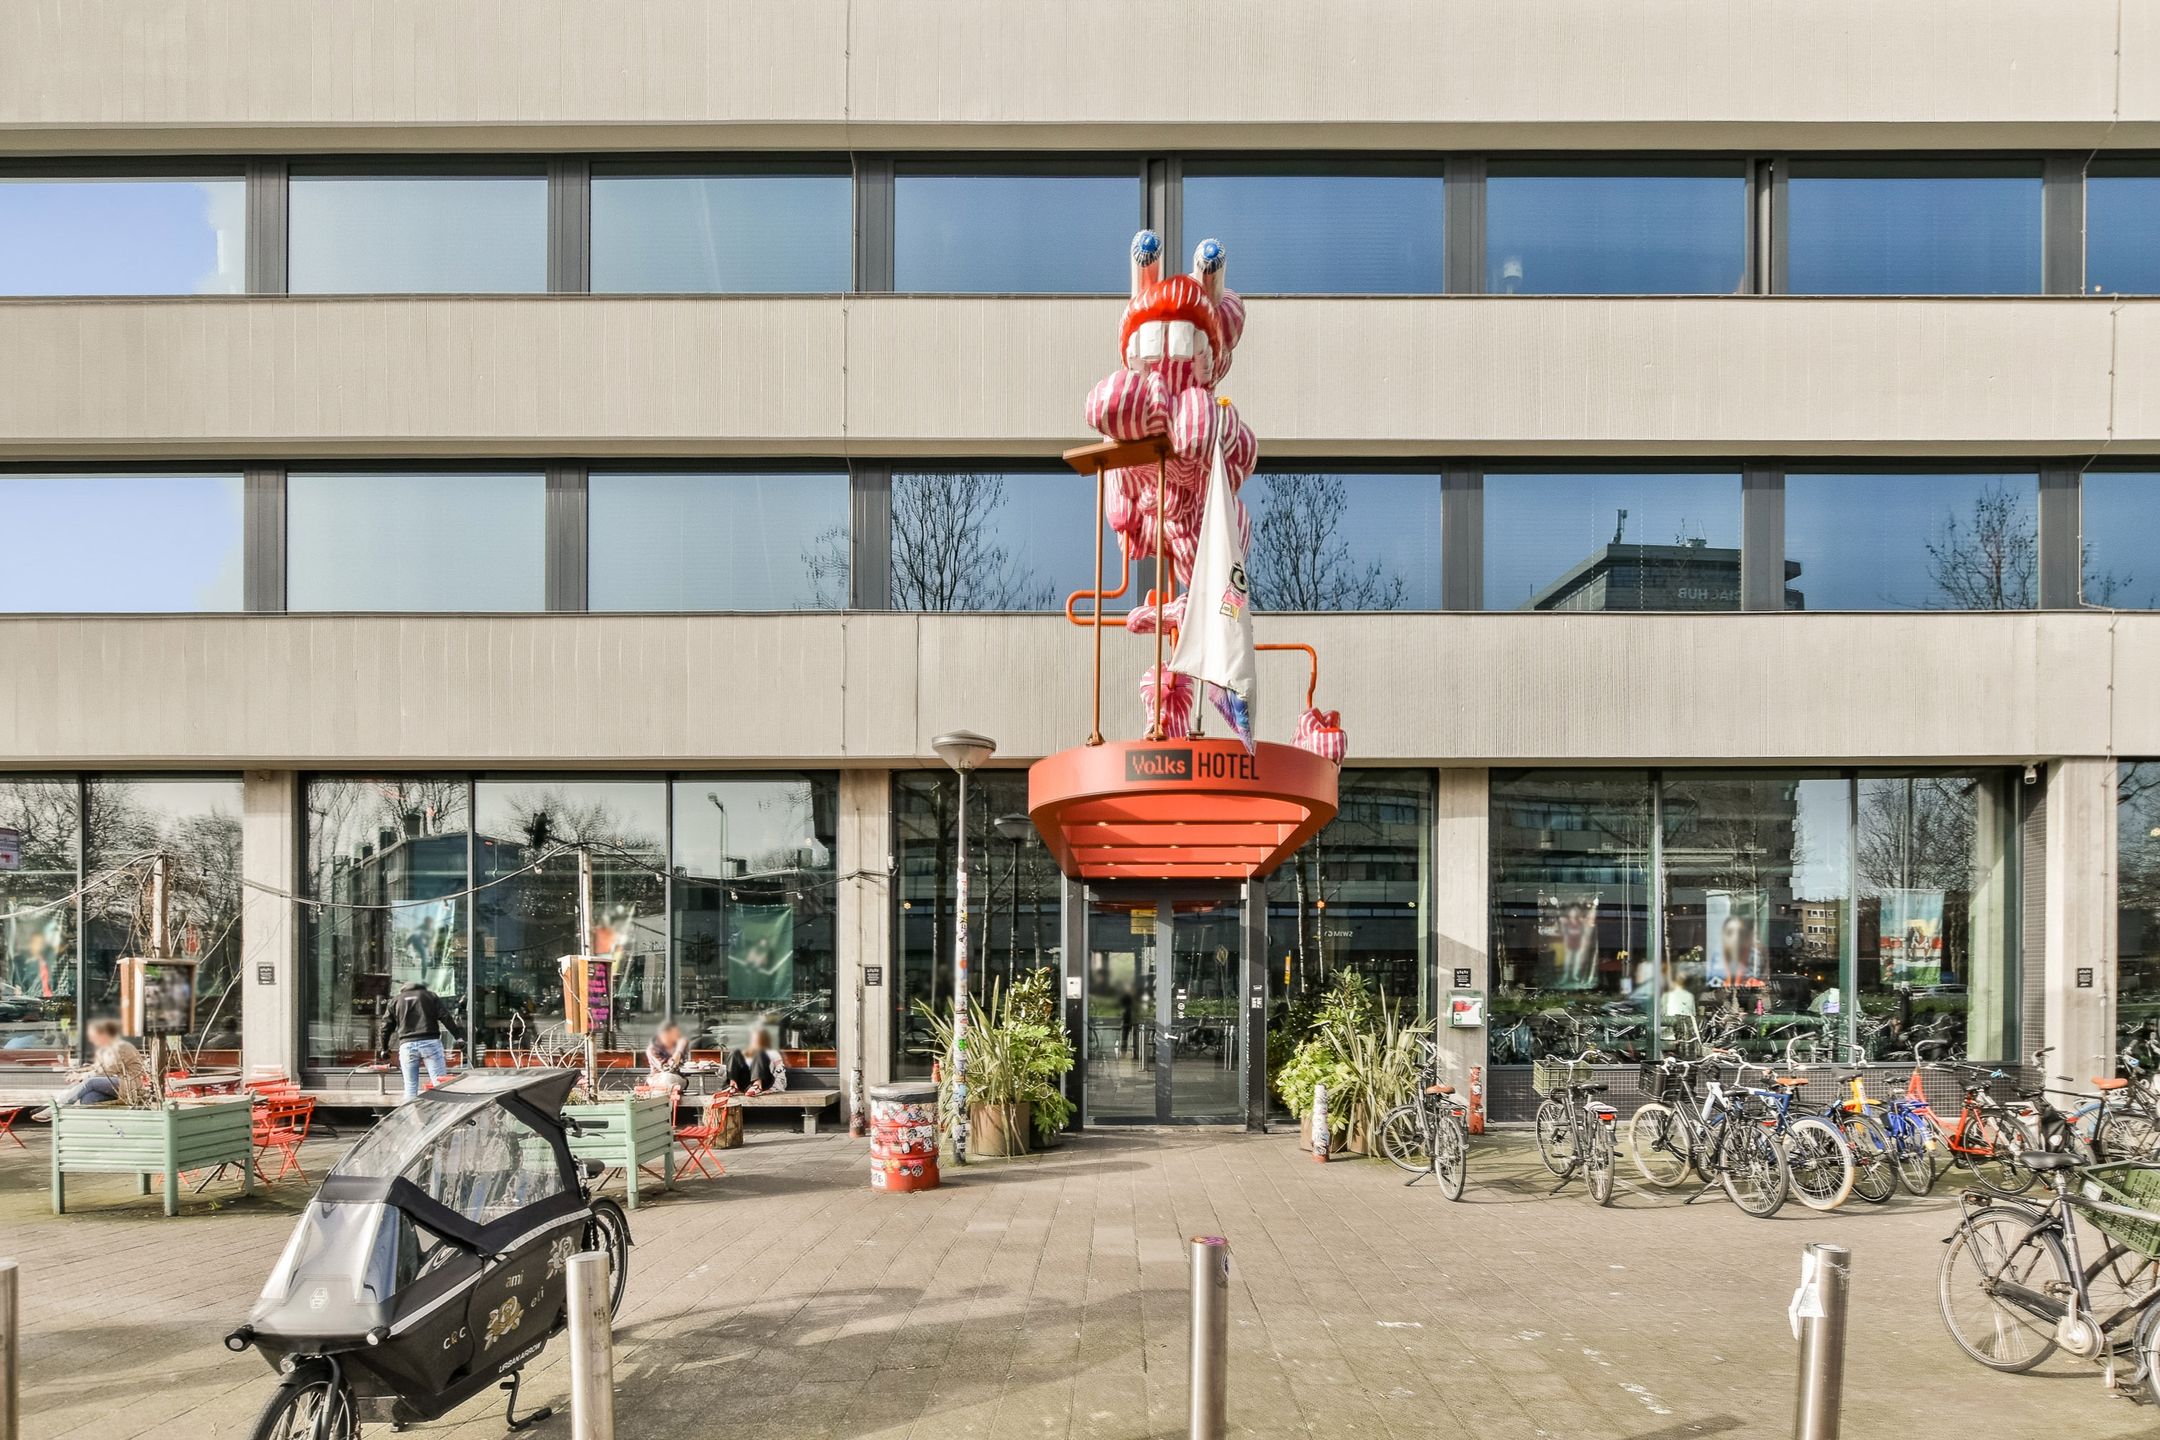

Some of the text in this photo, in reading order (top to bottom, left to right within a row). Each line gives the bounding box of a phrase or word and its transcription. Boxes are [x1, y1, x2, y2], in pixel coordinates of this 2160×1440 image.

[1132, 752, 1259, 780] Volks HOTEL
[505, 1269, 524, 1288] ami
[530, 1286, 544, 1307] eli
[498, 1341, 542, 1373] URBAN ARROW
